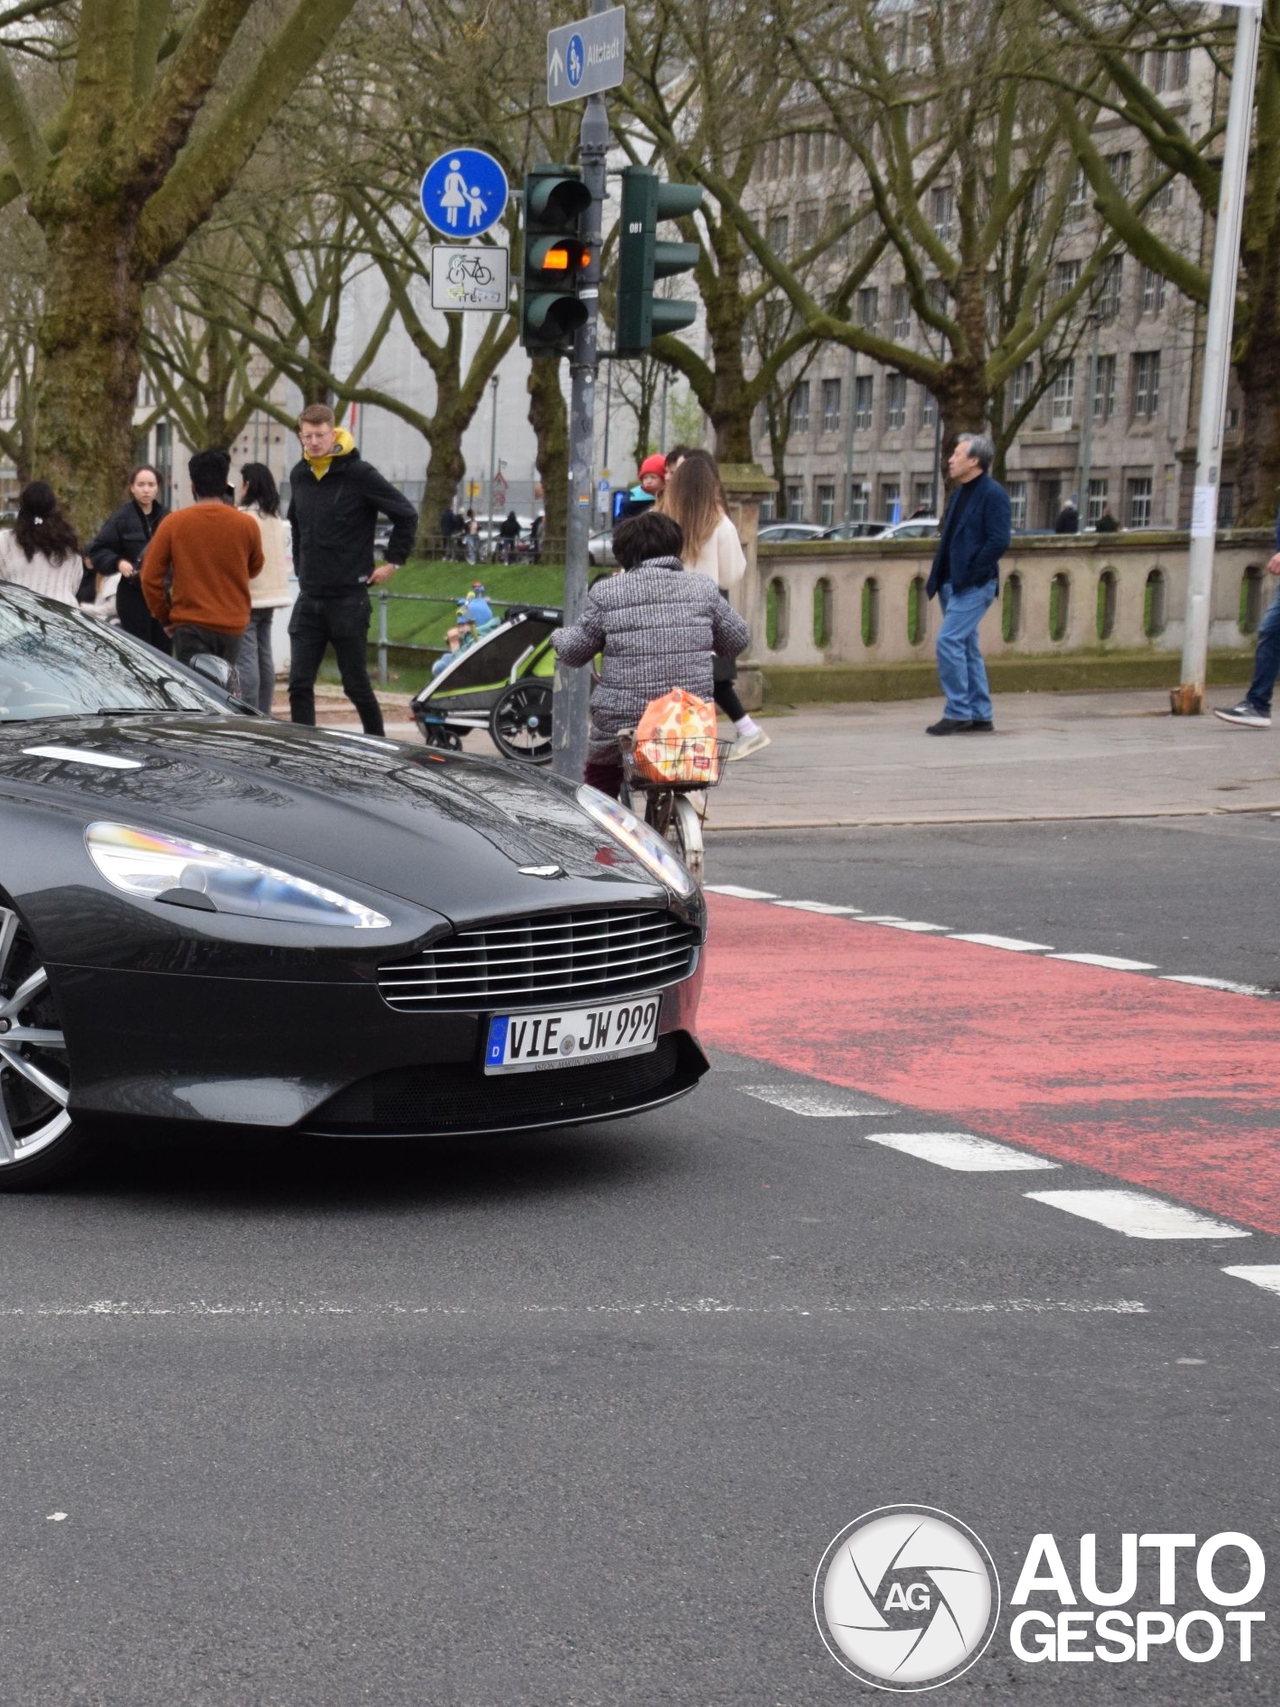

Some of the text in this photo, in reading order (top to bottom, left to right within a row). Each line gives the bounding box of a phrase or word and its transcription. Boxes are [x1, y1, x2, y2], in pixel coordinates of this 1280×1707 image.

[587, 37, 619, 66] Altstadt
[510, 1002, 656, 1059] VIE JW 999
[492, 1046, 500, 1058] D
